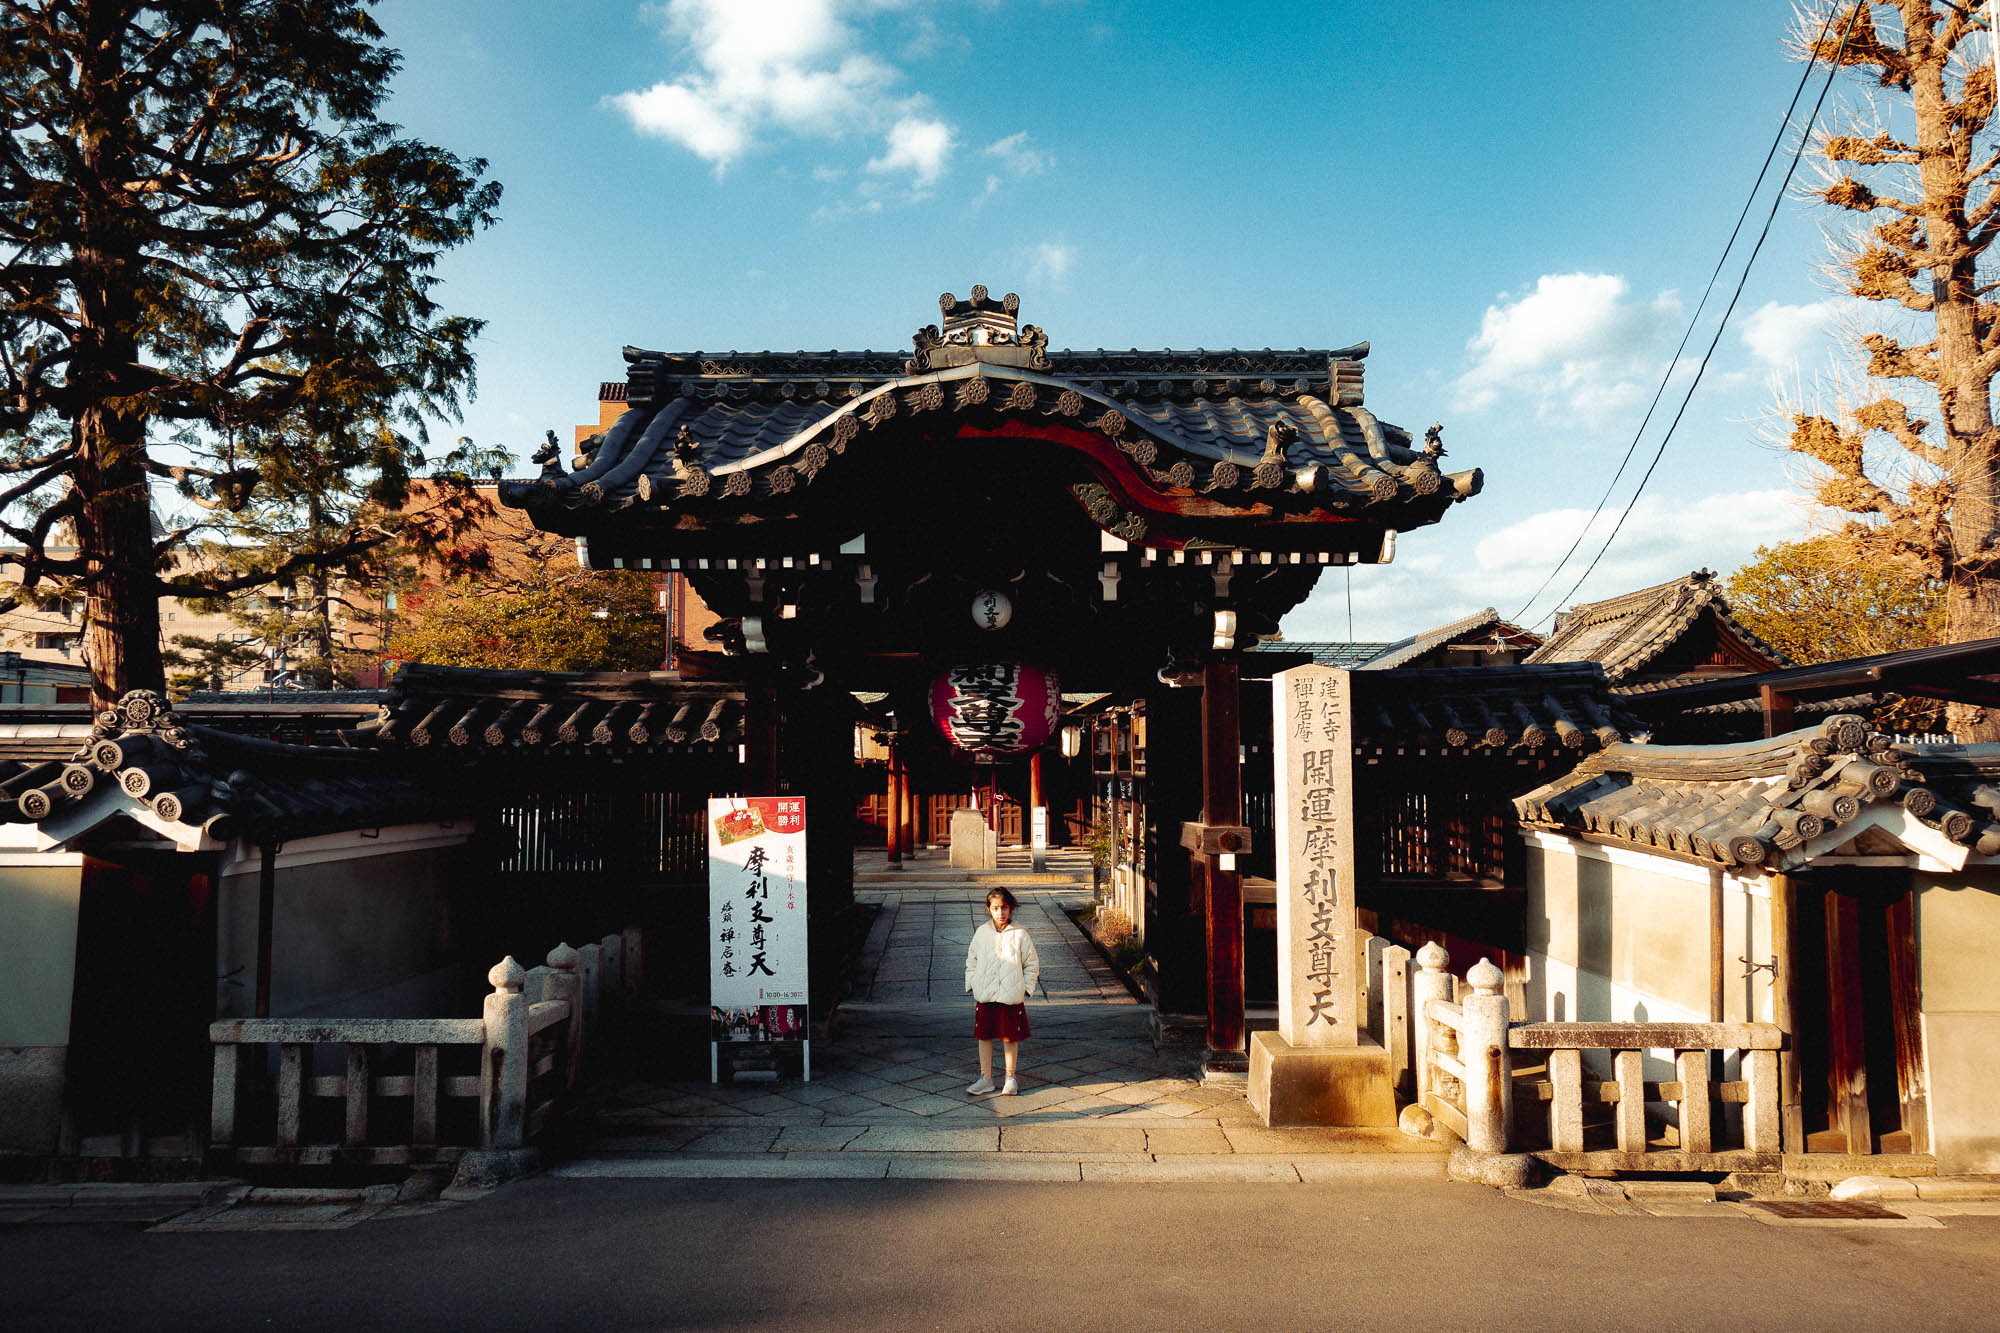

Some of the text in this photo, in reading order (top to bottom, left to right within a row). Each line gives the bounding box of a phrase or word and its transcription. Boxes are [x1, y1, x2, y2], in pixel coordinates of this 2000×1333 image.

[1320, 676, 1341, 742] 建仁寺
[777, 801, 801, 813] 開運
[777, 815, 800, 827] 勝利
[741, 845, 776, 977] 摩利支尊天
[1301, 749, 1340, 1027] 開運摩利支尊天
